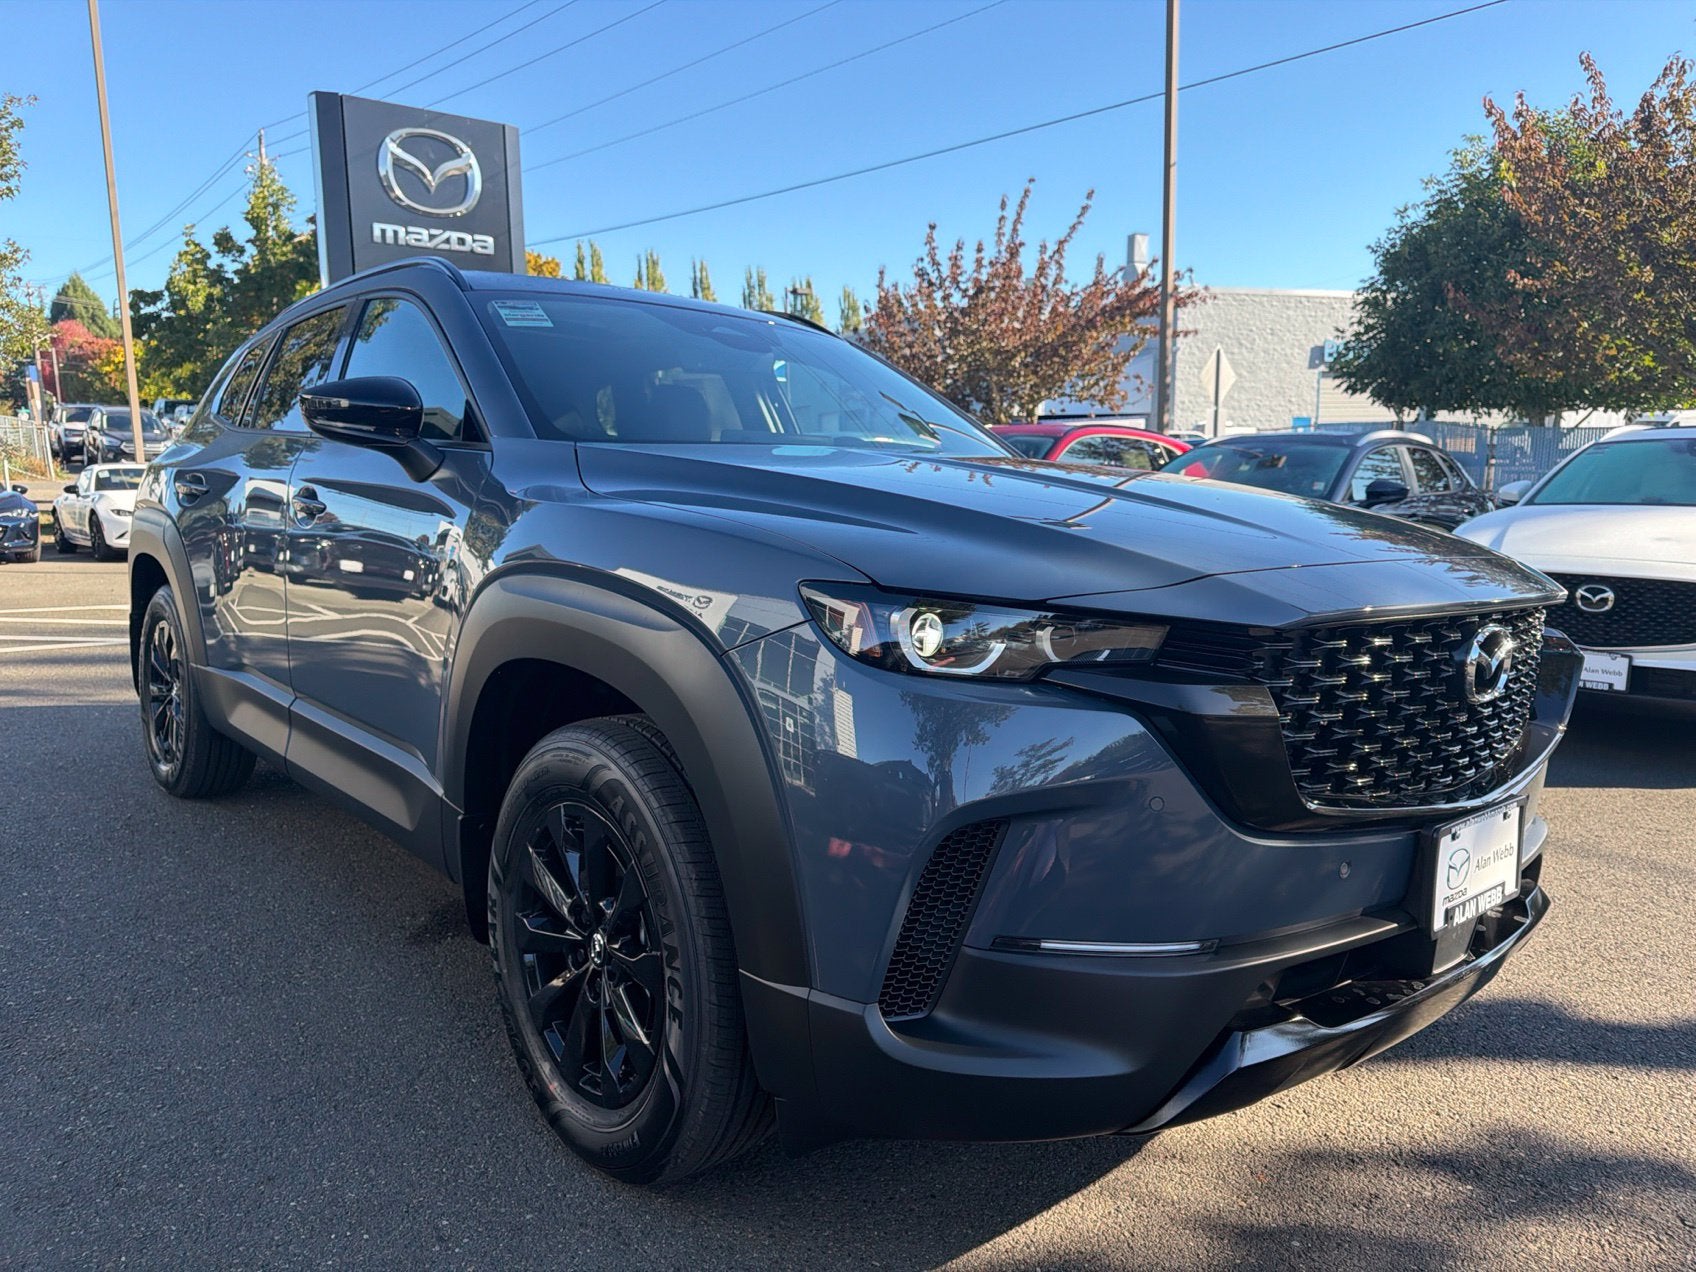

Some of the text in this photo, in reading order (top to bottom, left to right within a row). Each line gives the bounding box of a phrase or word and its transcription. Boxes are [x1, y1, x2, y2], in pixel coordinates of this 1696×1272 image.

[1601, 668, 1623, 677] Webb
[1474, 842, 1515, 872] Alan Webb
[1453, 886, 1503, 926] ALAN WEBB
